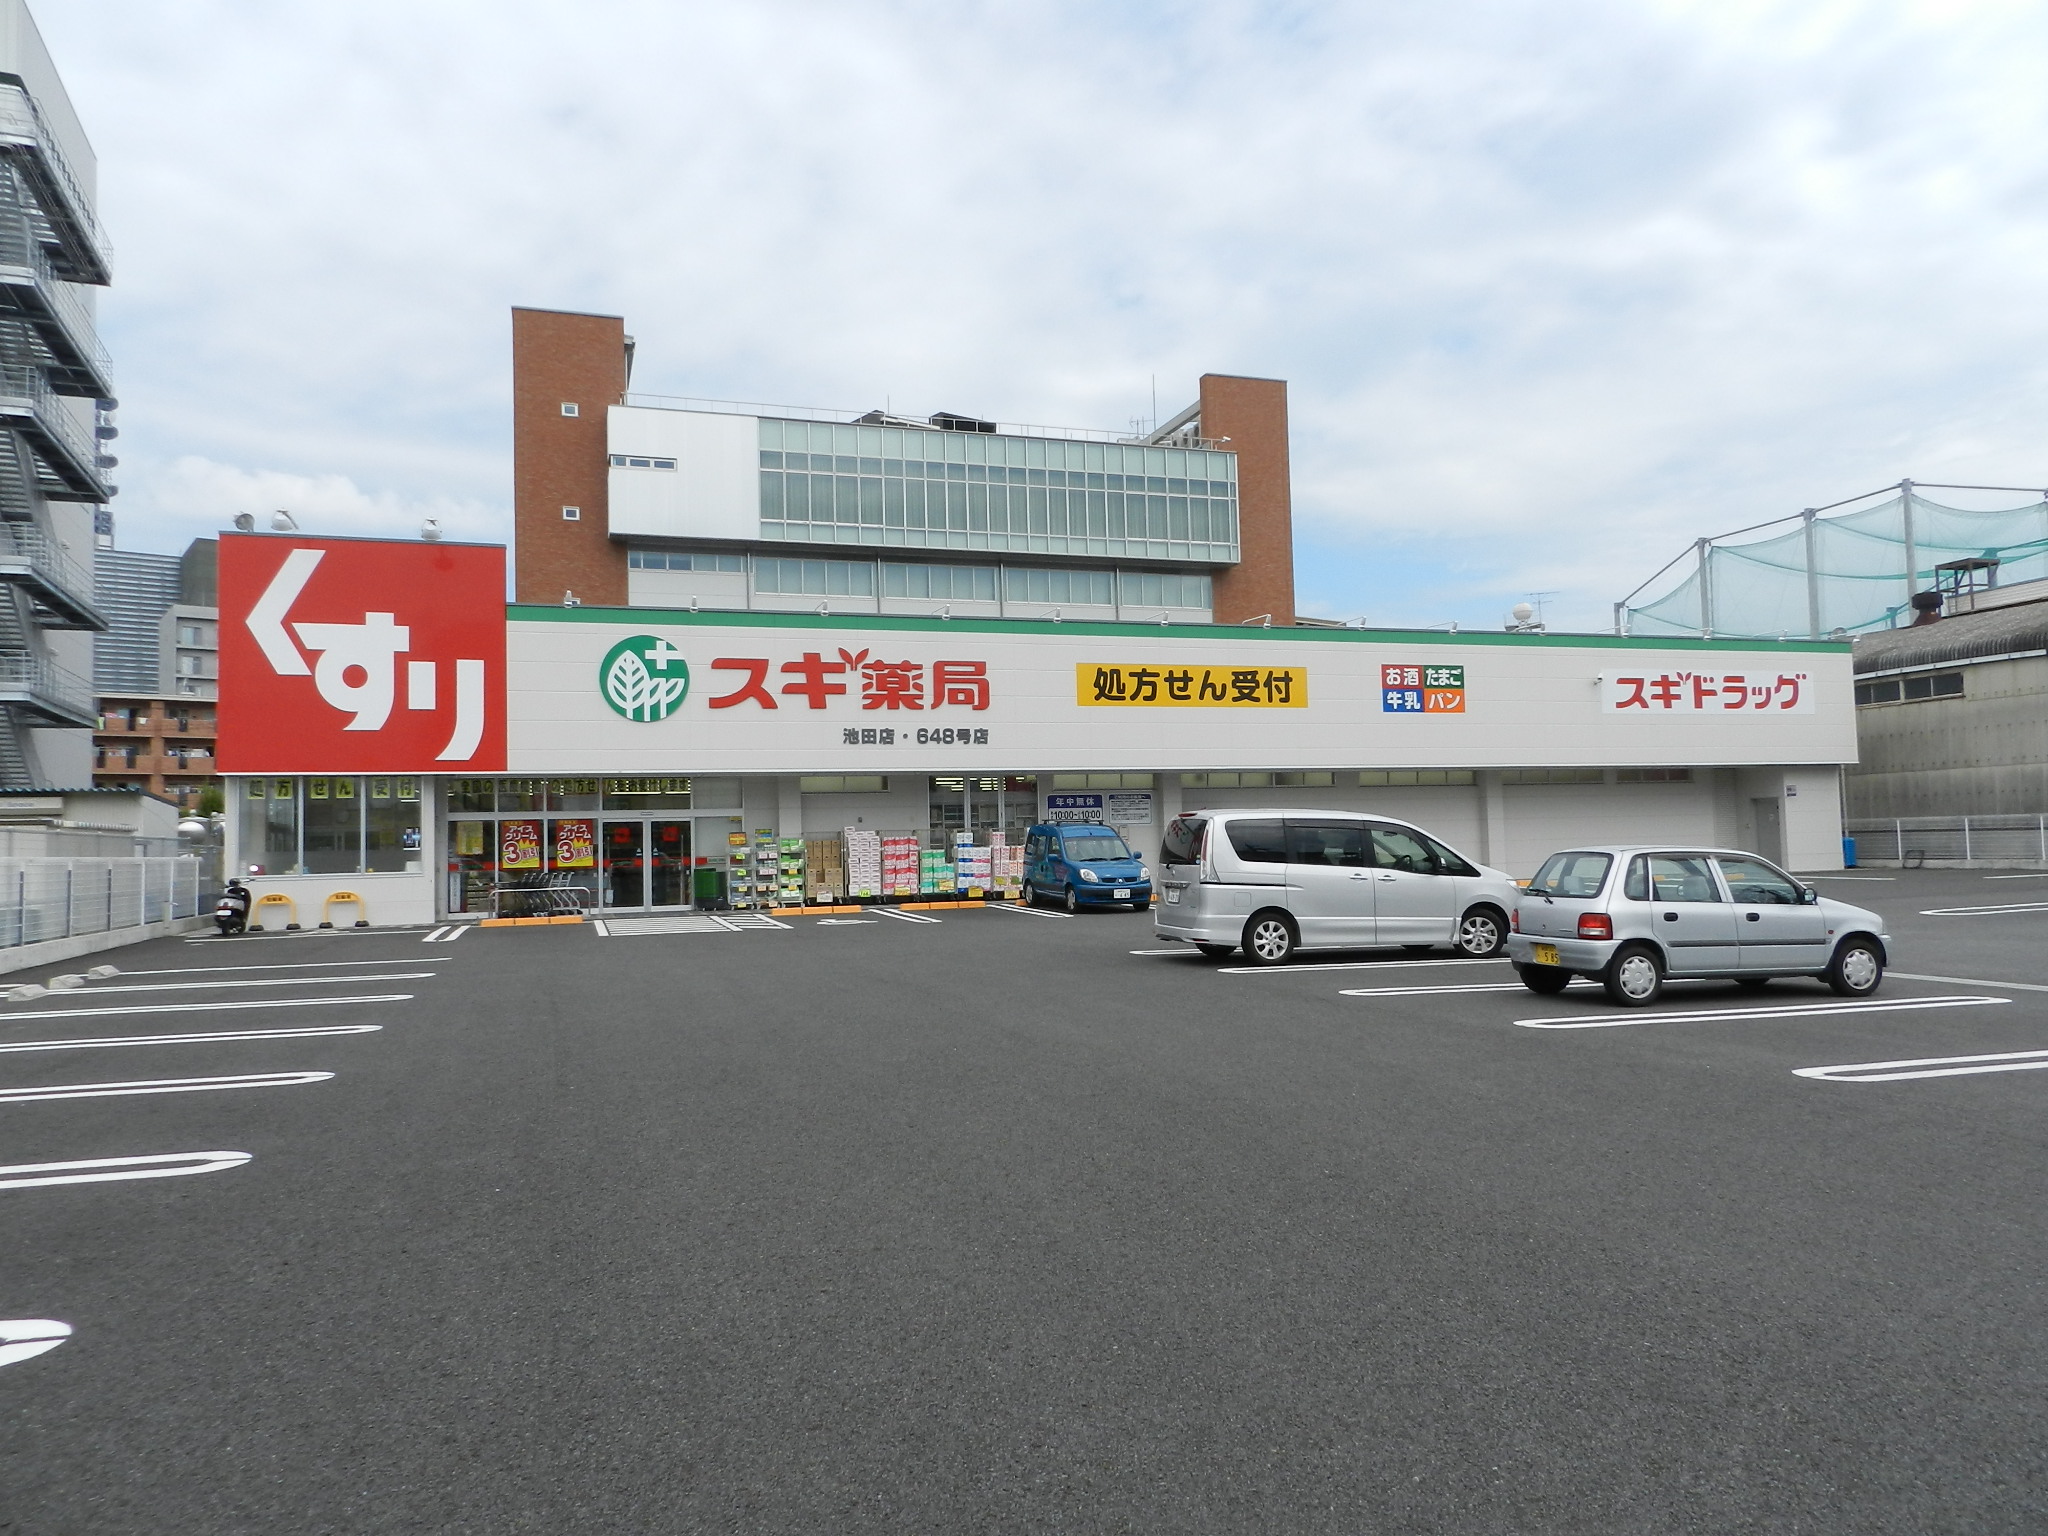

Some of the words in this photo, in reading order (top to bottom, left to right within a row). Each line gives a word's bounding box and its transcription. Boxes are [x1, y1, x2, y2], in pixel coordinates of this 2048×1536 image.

[245, 548, 485, 761] くすり
[709, 648, 990, 710] スギ薬局
[1094, 667, 1293, 703] 処方せん受付
[1386, 668, 1419, 686] お酒
[1425, 668, 1462, 686] たまご
[1615, 671, 1807, 710] スギドラッグ
[1387, 691, 1421, 710] 牛乳
[1428, 692, 1461, 709] パン
[1055, 797, 1095, 807] 年中無休
[504, 832, 538, 840] クリーム
[509, 825, 534, 833] アイス
[558, 831, 592, 839] クリーム
[563, 824, 588, 832] アイス
